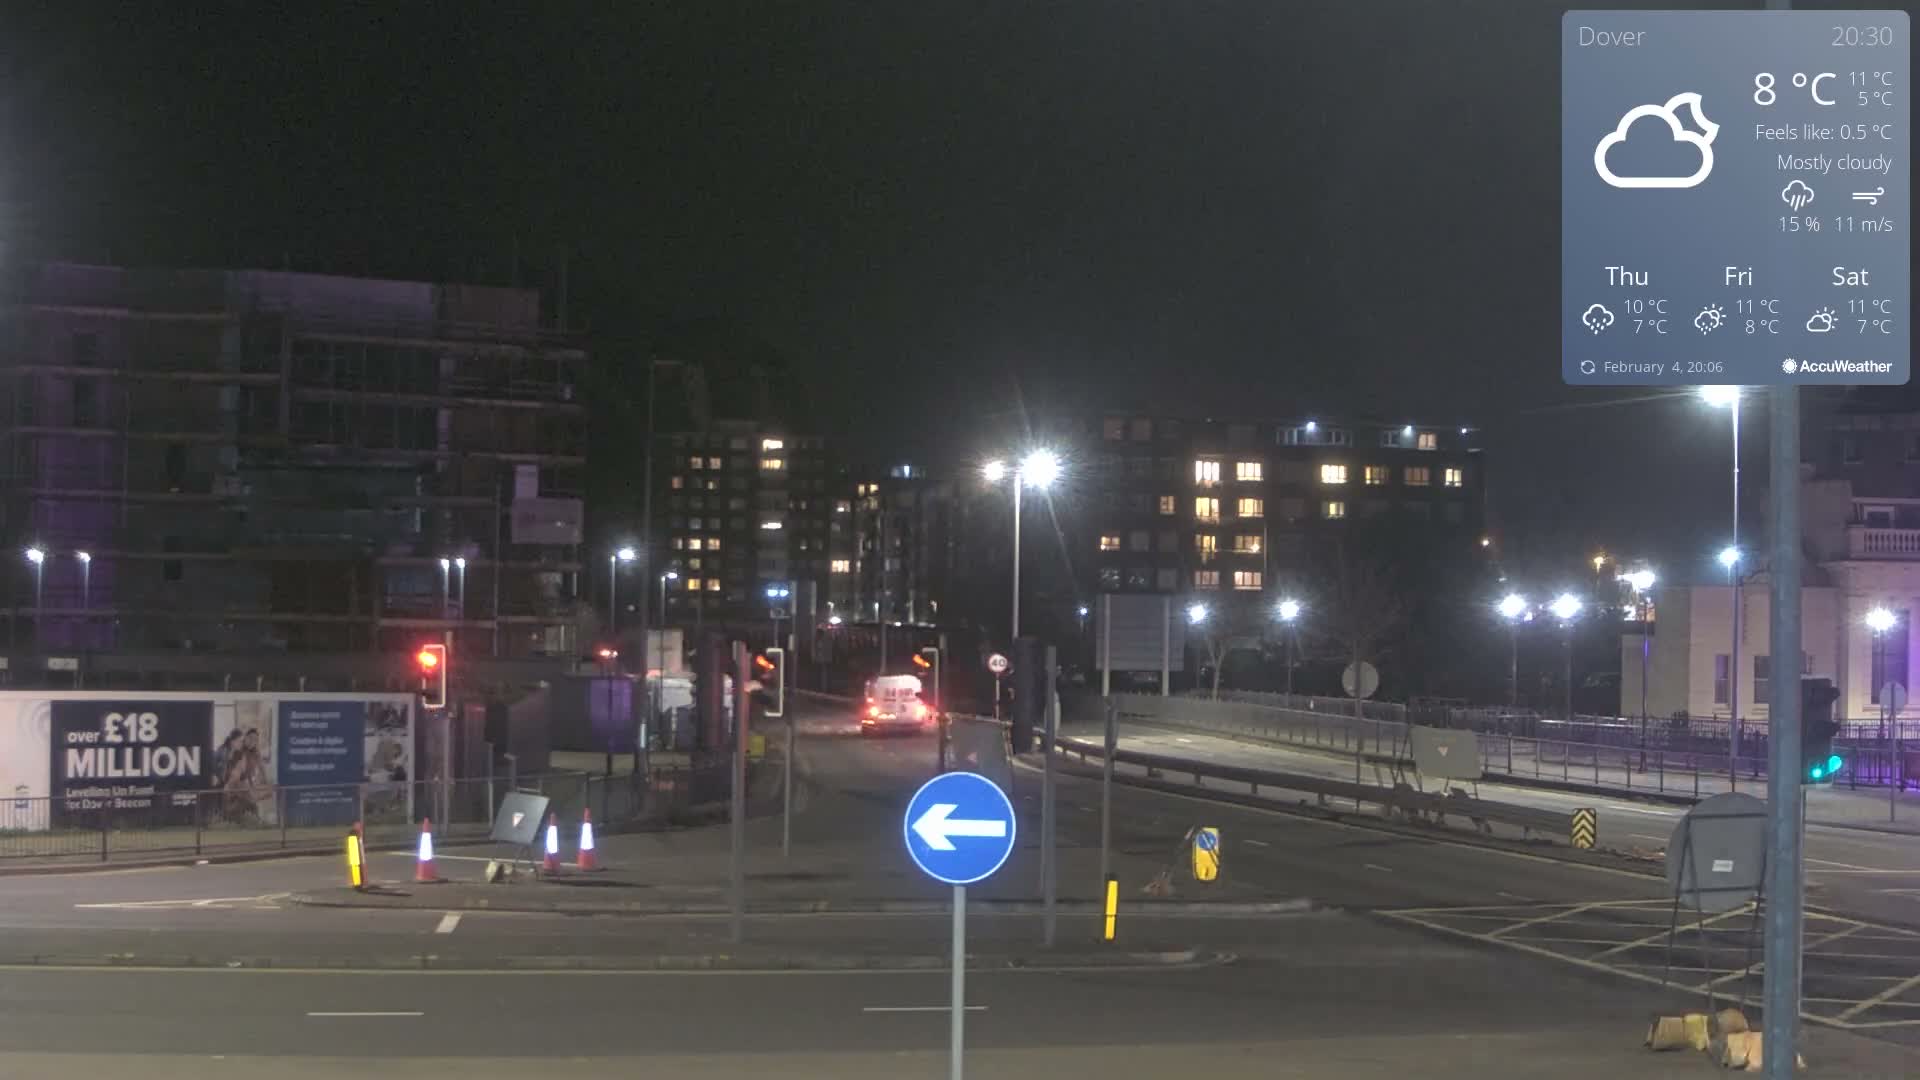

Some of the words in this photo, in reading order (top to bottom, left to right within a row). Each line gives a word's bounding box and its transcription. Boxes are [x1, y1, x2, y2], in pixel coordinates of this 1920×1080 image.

[992, 658, 1005, 667] 40
[67, 731, 101, 743] over
[104, 713, 157, 742] £18
[66, 746, 200, 778] MILLION
